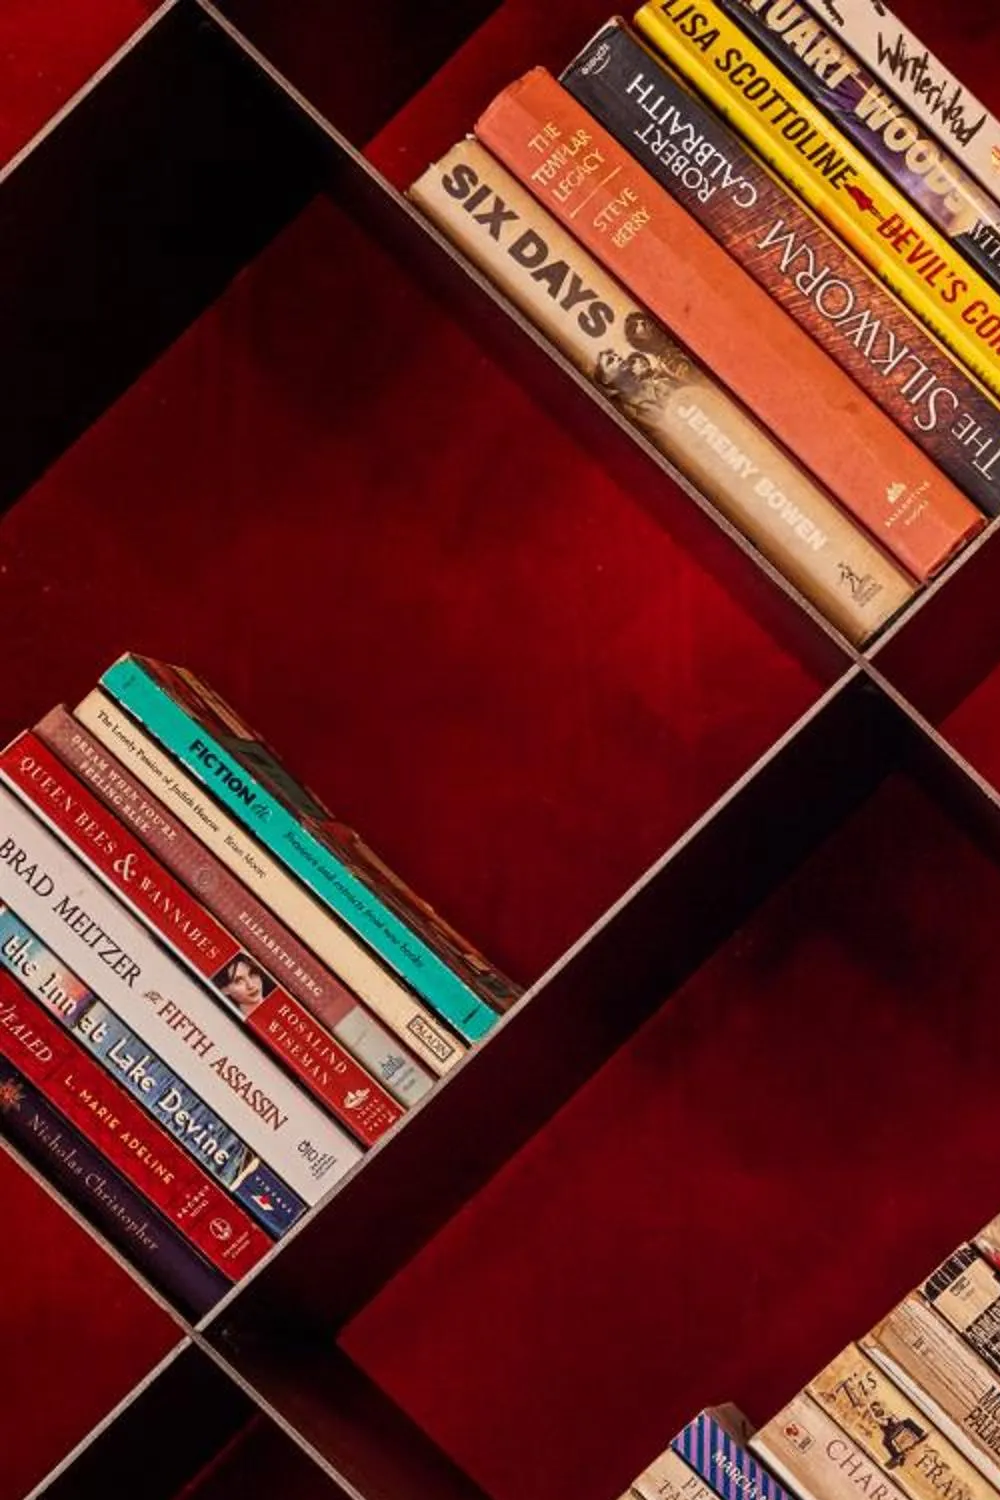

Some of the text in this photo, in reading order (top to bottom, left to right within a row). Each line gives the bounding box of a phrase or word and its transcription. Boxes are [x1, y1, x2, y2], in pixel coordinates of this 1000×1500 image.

[625, 73, 758, 209] GALBRAITH
[634, 121, 717, 203] ROBERT
[659, 0, 856, 191] LISA SCOTTOLINE
[439, 160, 620, 341] SIX DAYS
[876, 212, 967, 303] DEVIL'S
[754, 220, 958, 431] SILKWORM
[673, 396, 831, 552] JEREMY BOWEN
[96, 710, 113, 728] The
[110, 724, 136, 753] Lonely
[135, 748, 163, 777] Passion
[161, 774, 173, 785] of
[167, 783, 194, 808] Judith
[189, 738, 256, 806] FICTION
[0, 837, 142, 987] BRAD MELTZER
[19, 756, 219, 959] QUEEN BEES & WANNABES
[223, 834, 266, 878] Brian Moore
[0, 929, 232, 1165] the Inn at Lake Devine
[157, 1000, 288, 1130] FIFTH ASSASSIN
[267, 1020, 329, 1085] WISEMAN
[277, 1004, 347, 1074] ROSALIND
[26, 1114, 160, 1251] Nicholas Christopher
[64, 1074, 174, 1184] L. MARIE ADELINE
